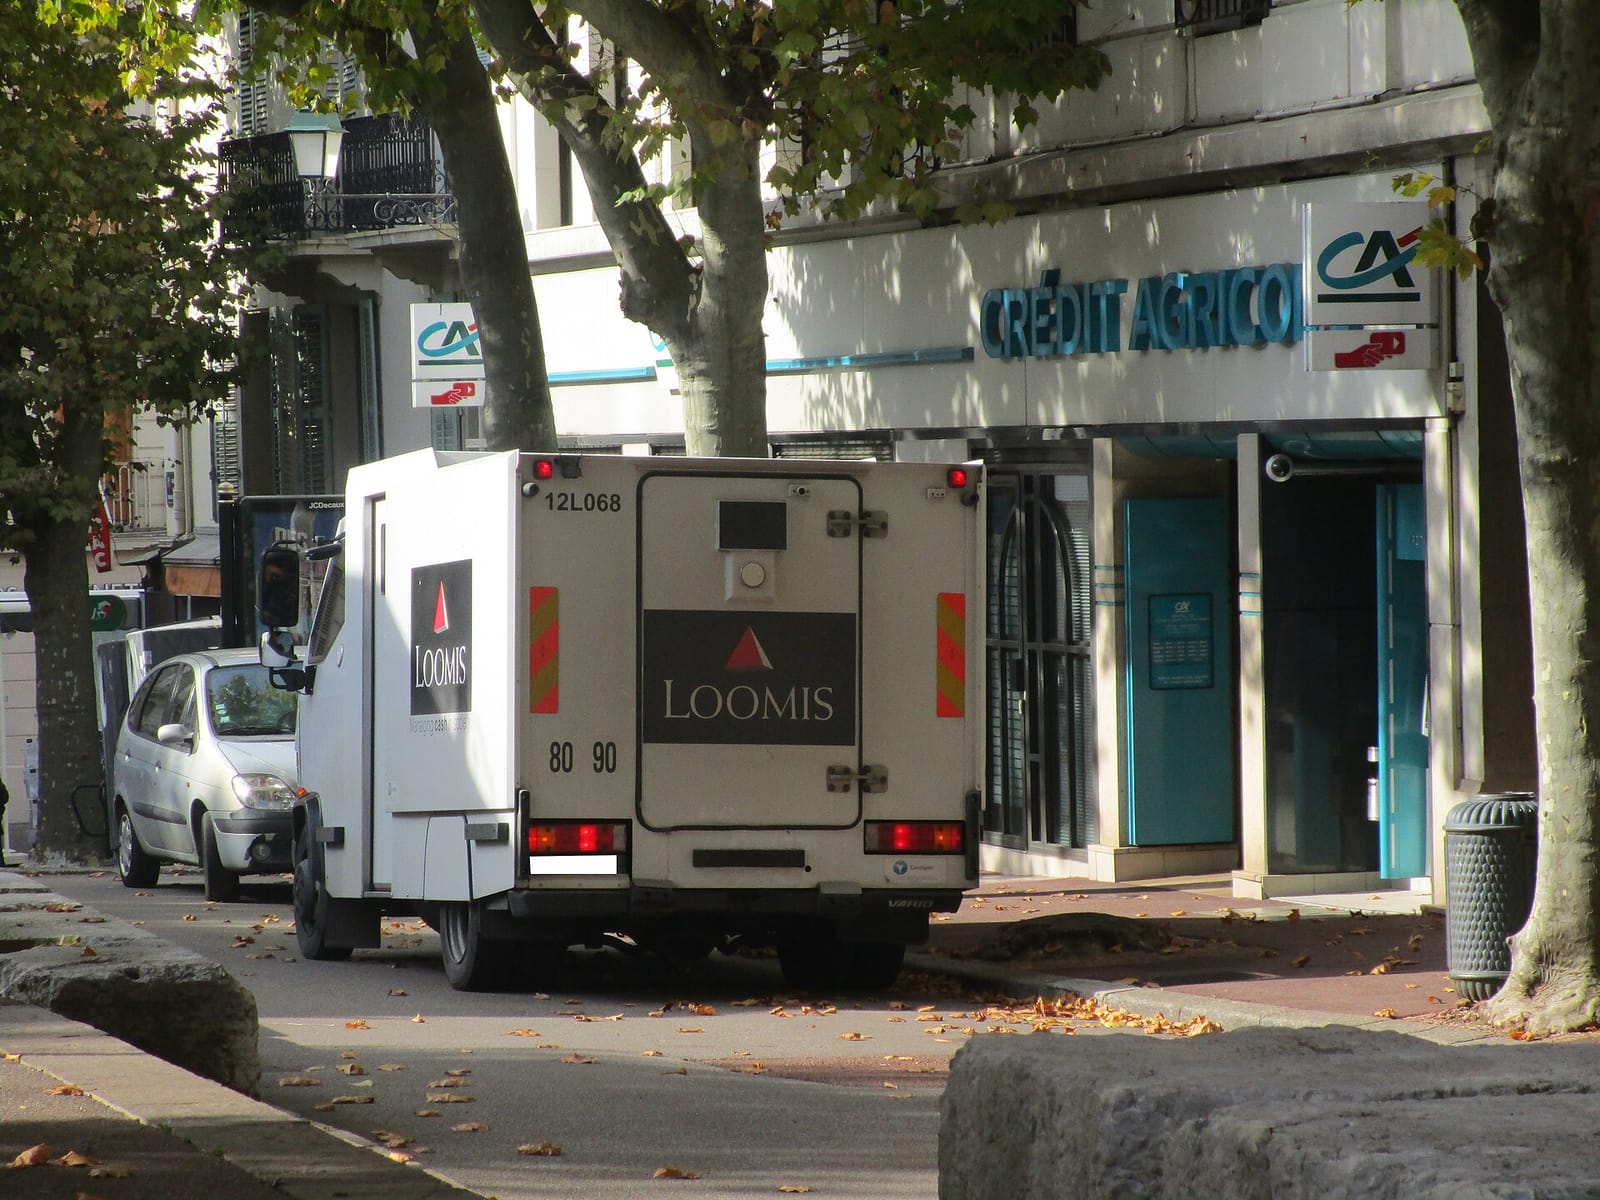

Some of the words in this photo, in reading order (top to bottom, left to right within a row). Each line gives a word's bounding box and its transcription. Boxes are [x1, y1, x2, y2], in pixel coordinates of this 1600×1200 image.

[980, 269, 1128, 358] CRÉDIT
[545, 492, 621, 512] 12L068
[415, 645, 466, 688] LOOMIS
[663, 679, 833, 721] LOOMIS
[550, 741, 573, 773] 80
[593, 741, 617, 773] 90
